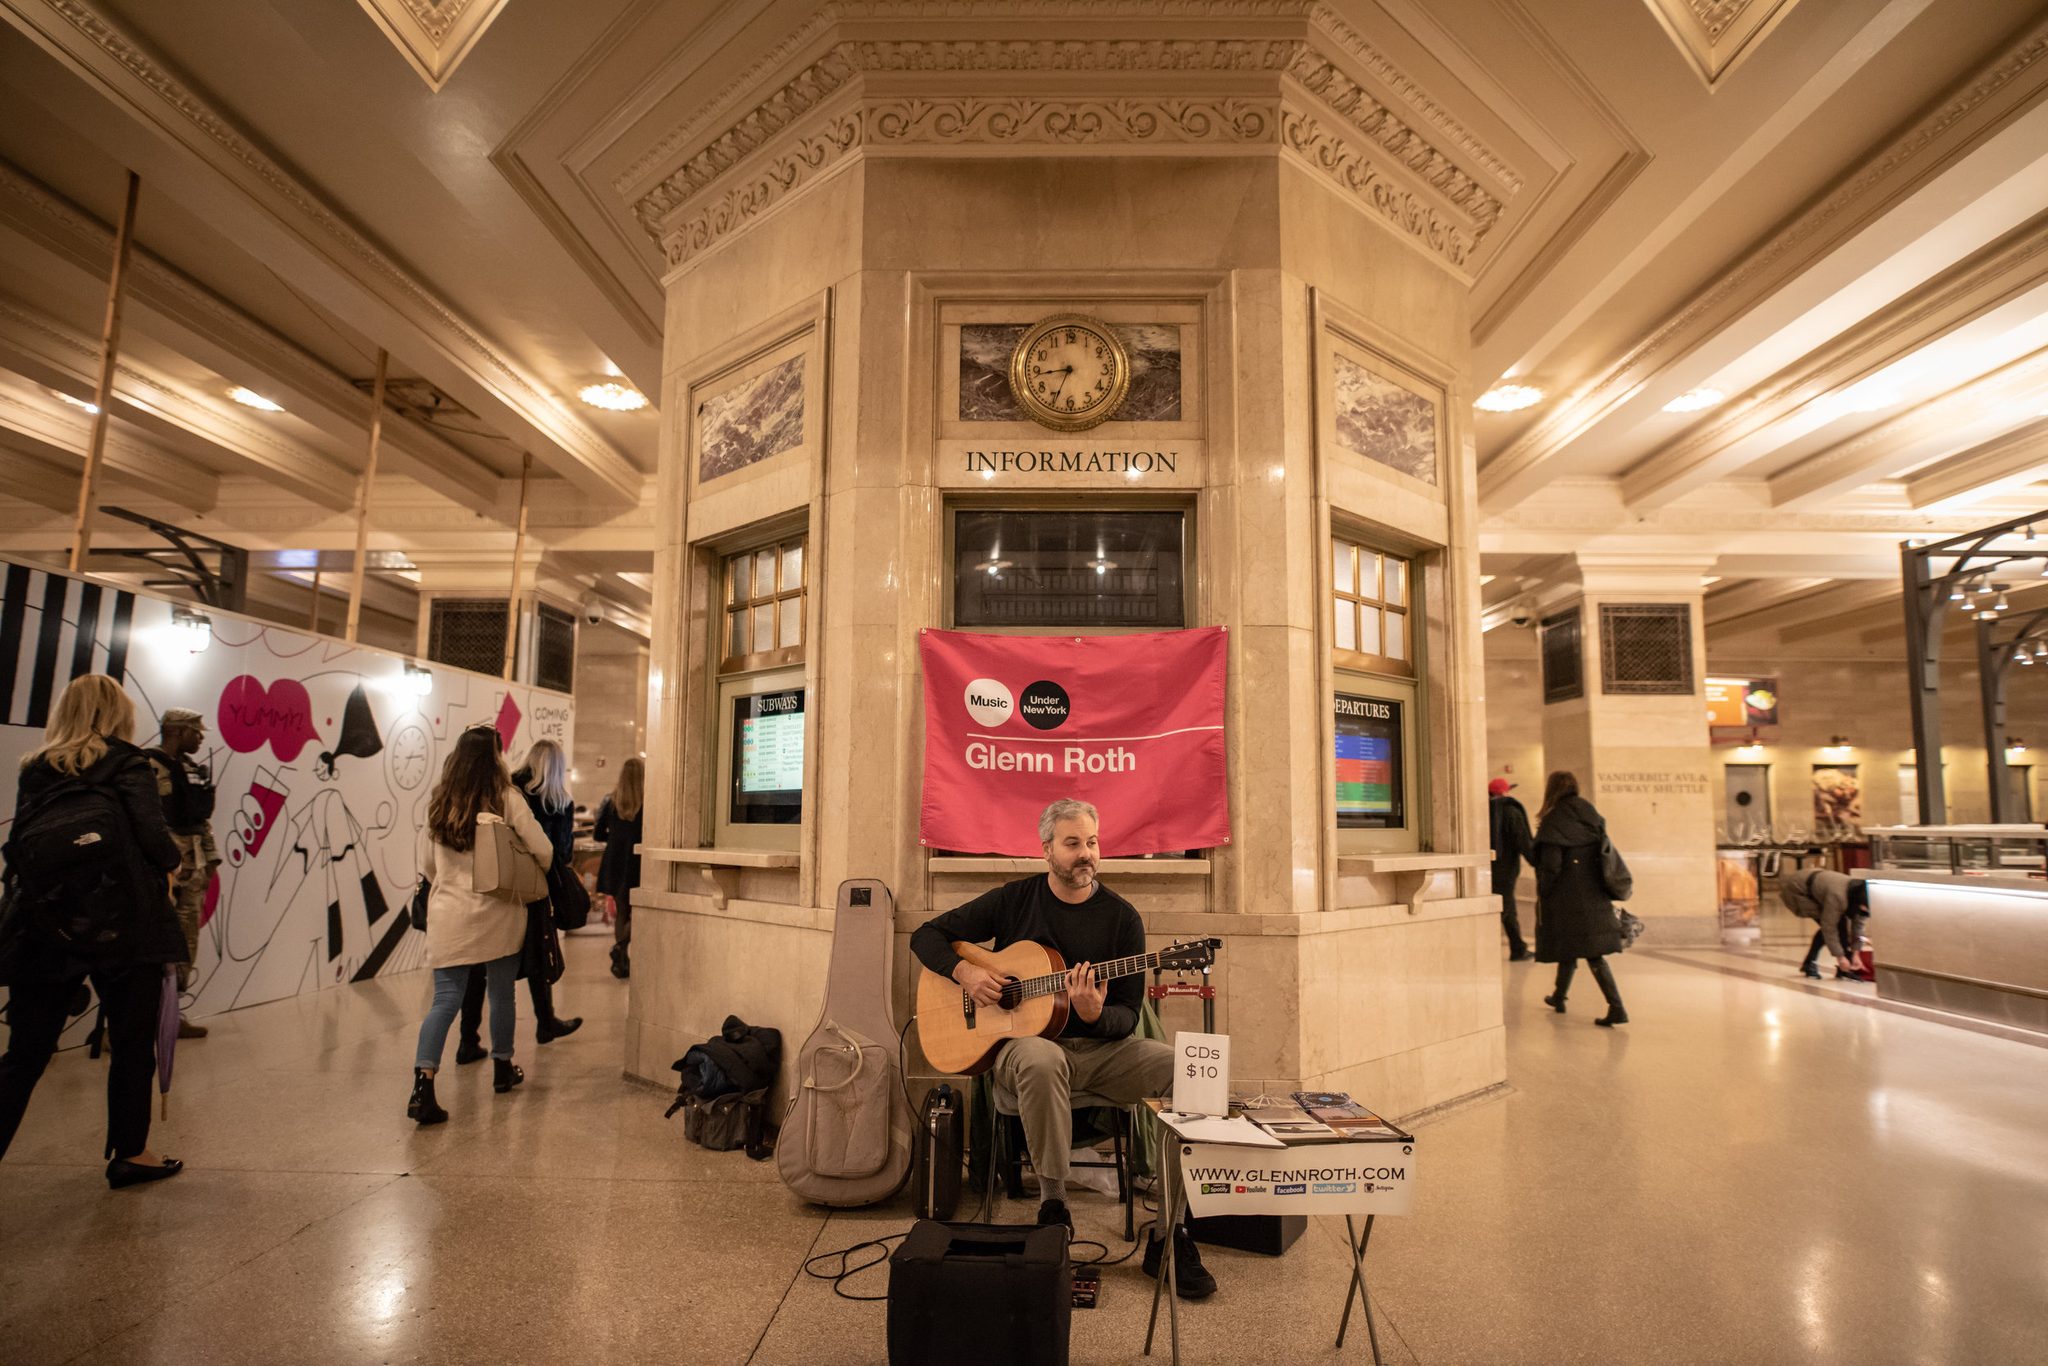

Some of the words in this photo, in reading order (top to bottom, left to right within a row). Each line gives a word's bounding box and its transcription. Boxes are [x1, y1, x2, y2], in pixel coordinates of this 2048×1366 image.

[1050, 336, 1058, 348] 11
[1065, 331, 1077, 345] 12
[1037, 349, 1048, 361] 10
[1033, 365, 1041, 378] 9
[1101, 363, 1109, 376] 3
[1038, 381, 1046, 393] 8
[1095, 379, 1104, 392] 4
[1050, 391, 1058, 405] 7
[1066, 395, 1075, 408] 6
[1083, 391, 1092, 404] 5
[966, 451, 1178, 473] INFORMATION
[757, 696, 798, 712] SUBWAYS
[970, 694, 1008, 708] Music
[1030, 695, 1060, 705] Under
[535, 706, 569, 721] COMING
[1023, 705, 1045, 714] New
[1045, 705, 1067, 715] York
[1334, 698, 1390, 719] EPARTURES
[229, 704, 304, 732] YUMMY!
[541, 723, 563, 736] LATE
[965, 742, 1054, 773] Glenn
[1064, 746, 1136, 774] Roth
[1186, 1062, 1218, 1079] $10
[1189, 1167, 1405, 1183] WWW.GLENNROTH.COM
[1276, 1186, 1304, 1194] facebook
[1313, 1184, 1345, 1193] twitter
